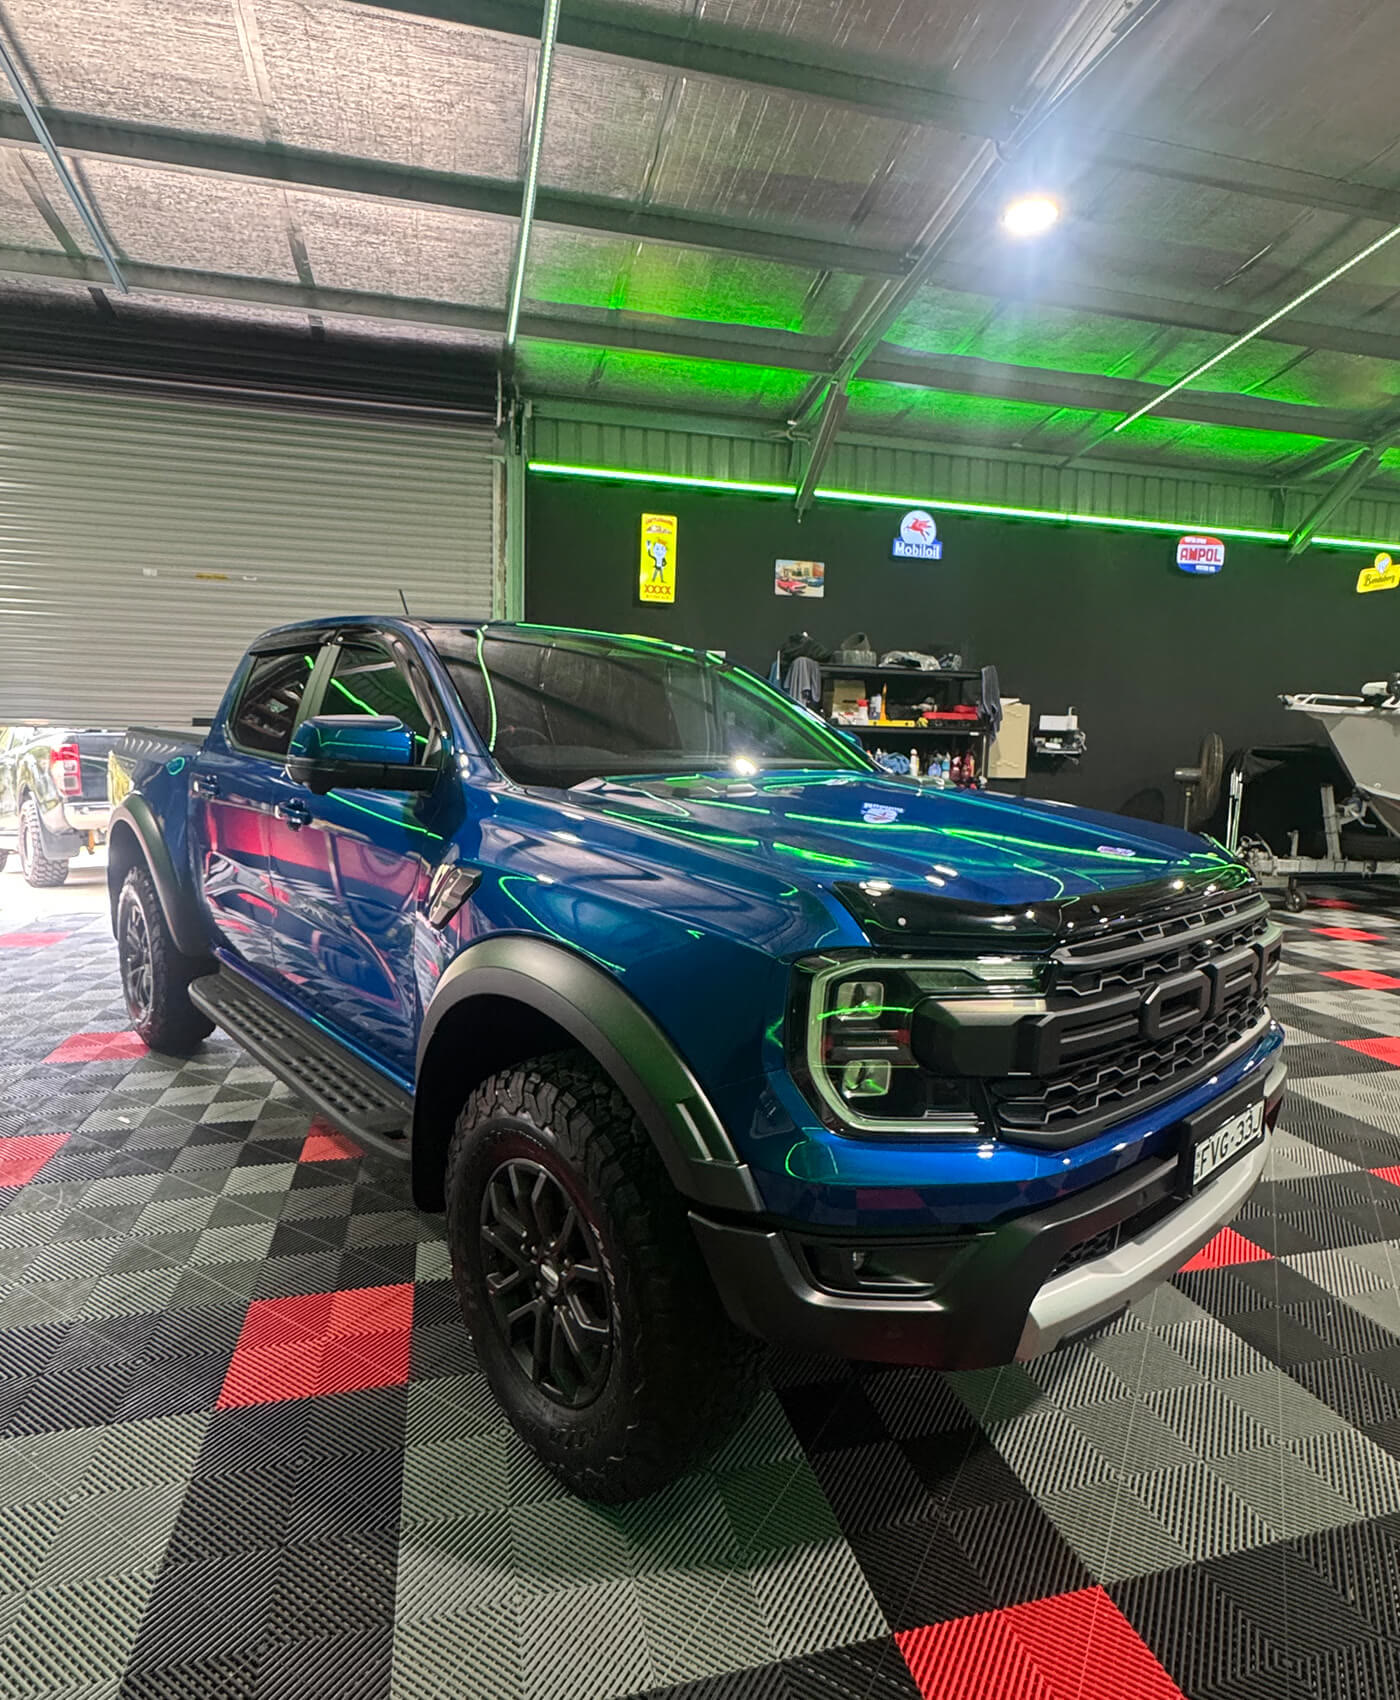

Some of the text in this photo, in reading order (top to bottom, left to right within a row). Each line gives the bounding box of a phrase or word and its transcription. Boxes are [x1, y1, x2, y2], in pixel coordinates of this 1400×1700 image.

[895, 541, 940, 559] Mobiloil
[1180, 547, 1221, 562] AMPOL
[645, 584, 671, 595] XXXX
